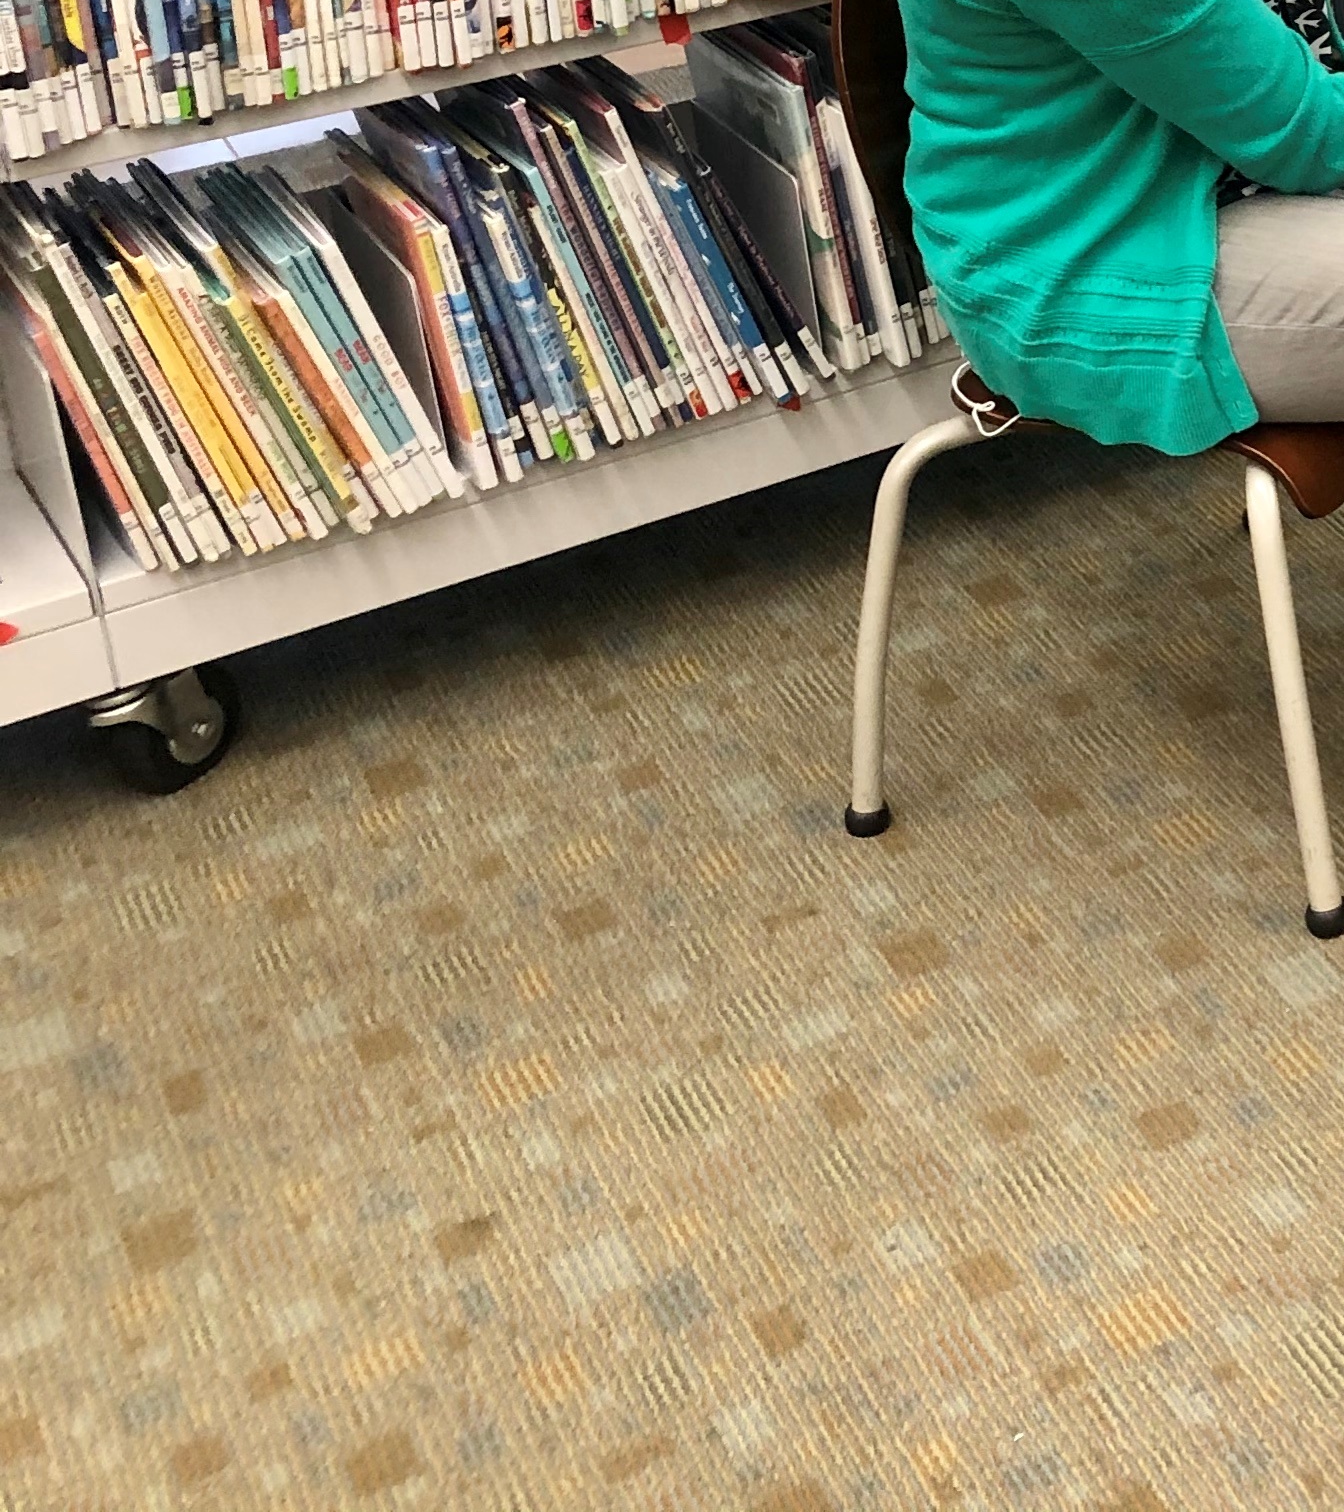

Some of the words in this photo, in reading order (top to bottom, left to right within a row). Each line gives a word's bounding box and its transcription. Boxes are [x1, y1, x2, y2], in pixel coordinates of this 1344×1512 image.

[176, 285, 203, 325] AMAZING
[199, 324, 221, 356] ANIMAL
[215, 355, 232, 376] HIDE
[227, 375, 243, 394] AND
[239, 394, 256, 417] SEEK
